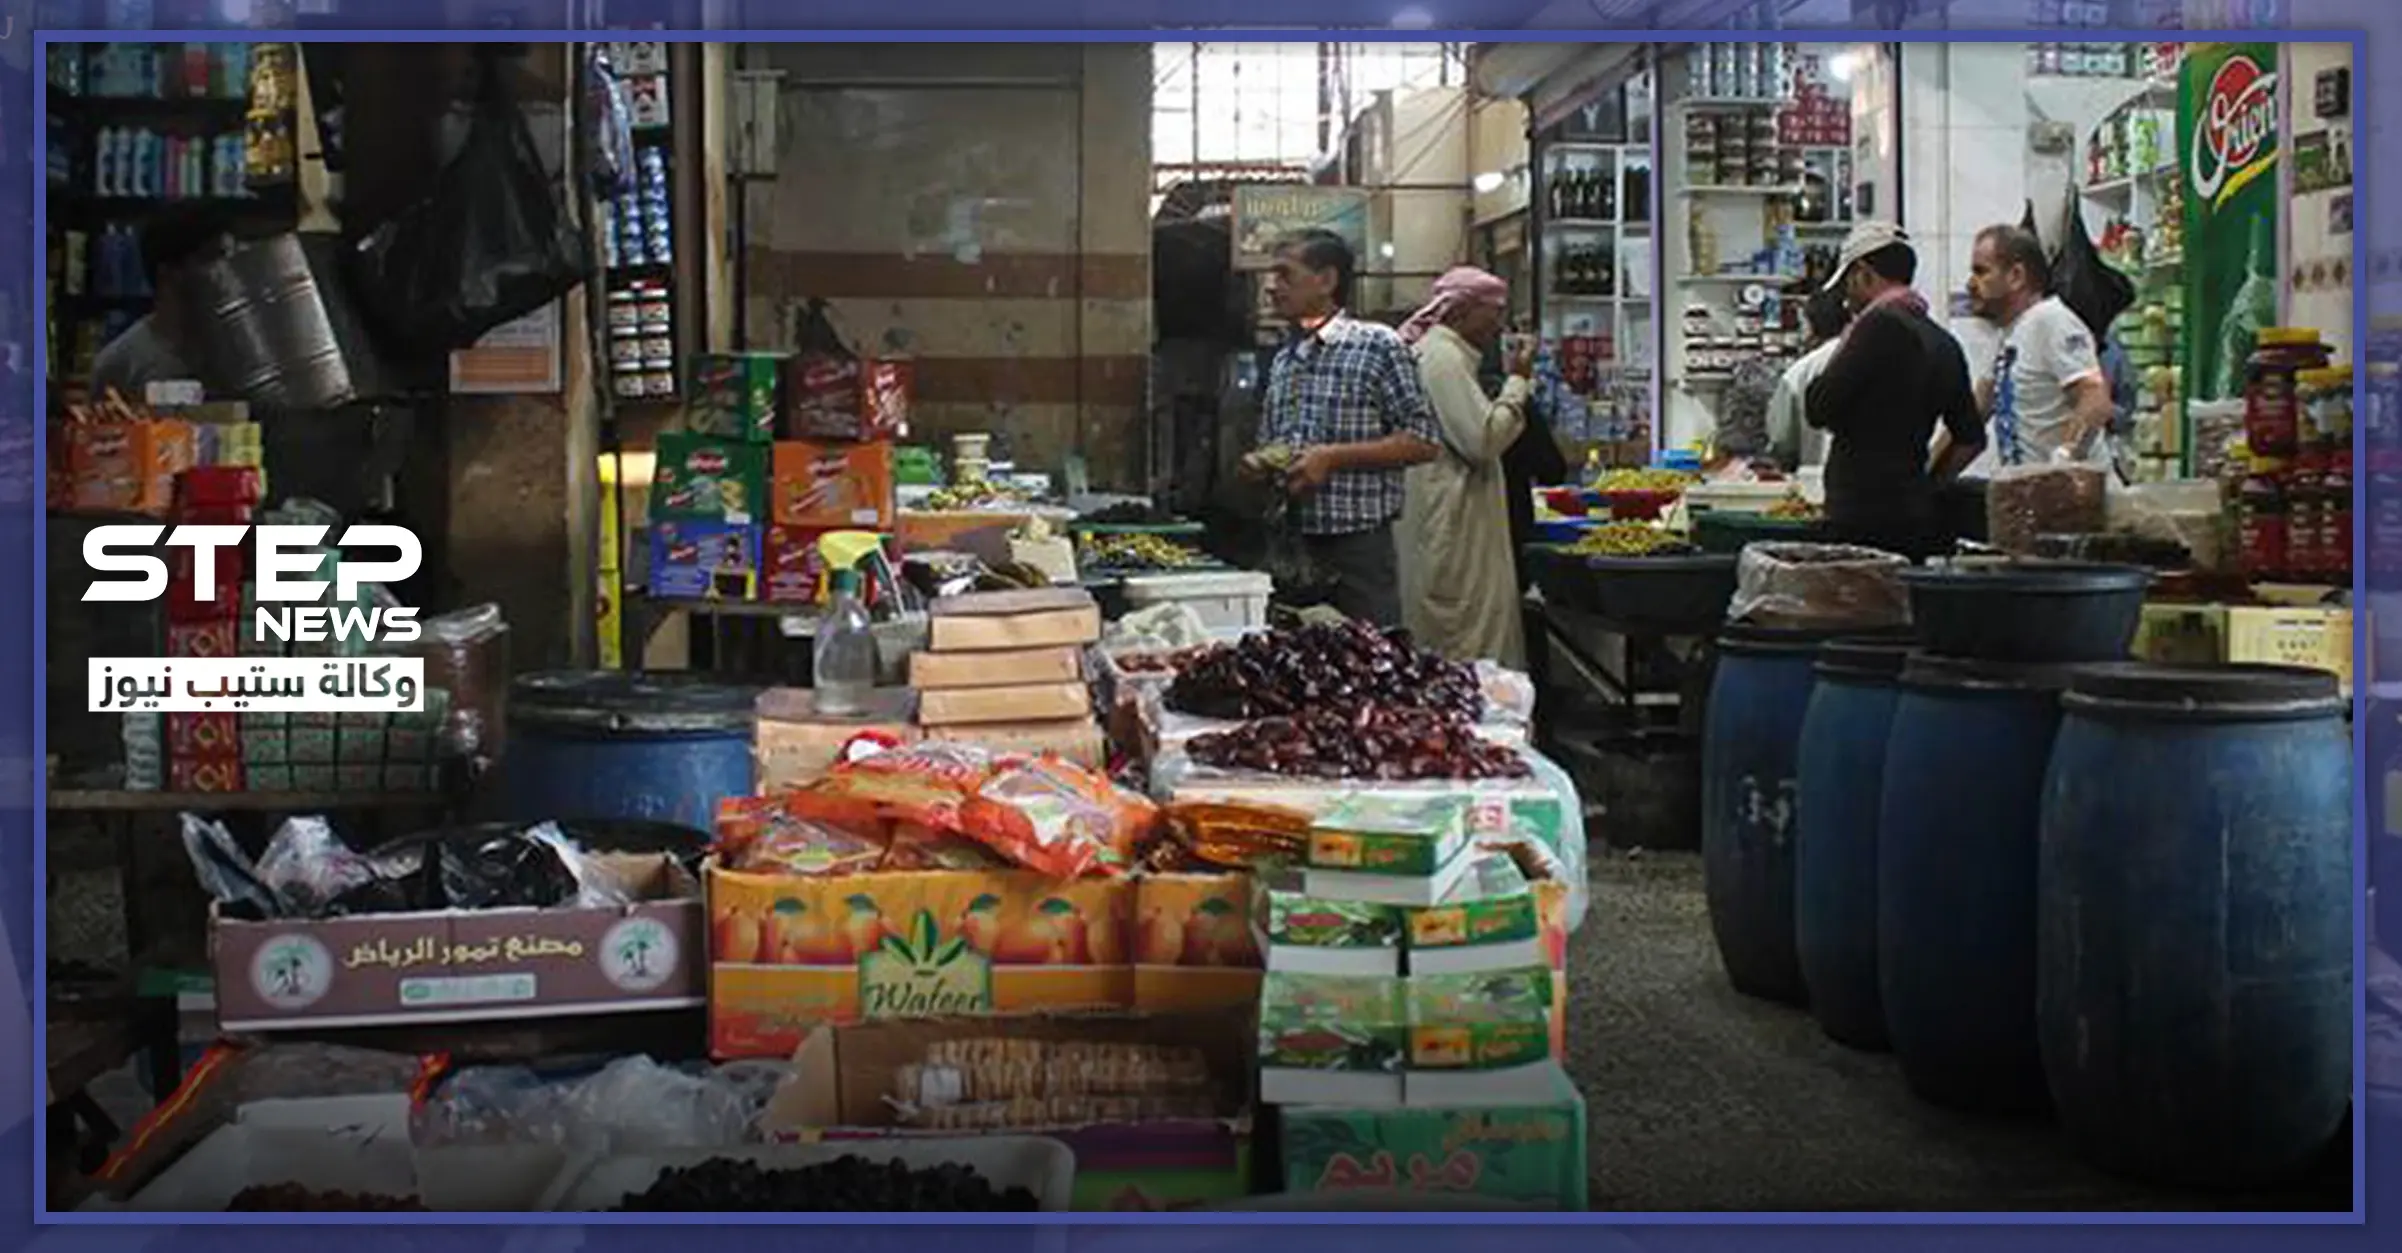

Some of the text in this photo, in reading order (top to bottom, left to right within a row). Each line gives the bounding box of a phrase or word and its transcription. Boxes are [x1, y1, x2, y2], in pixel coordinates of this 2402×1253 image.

[342, 933, 584, 968] مصنع تمور الرياض
